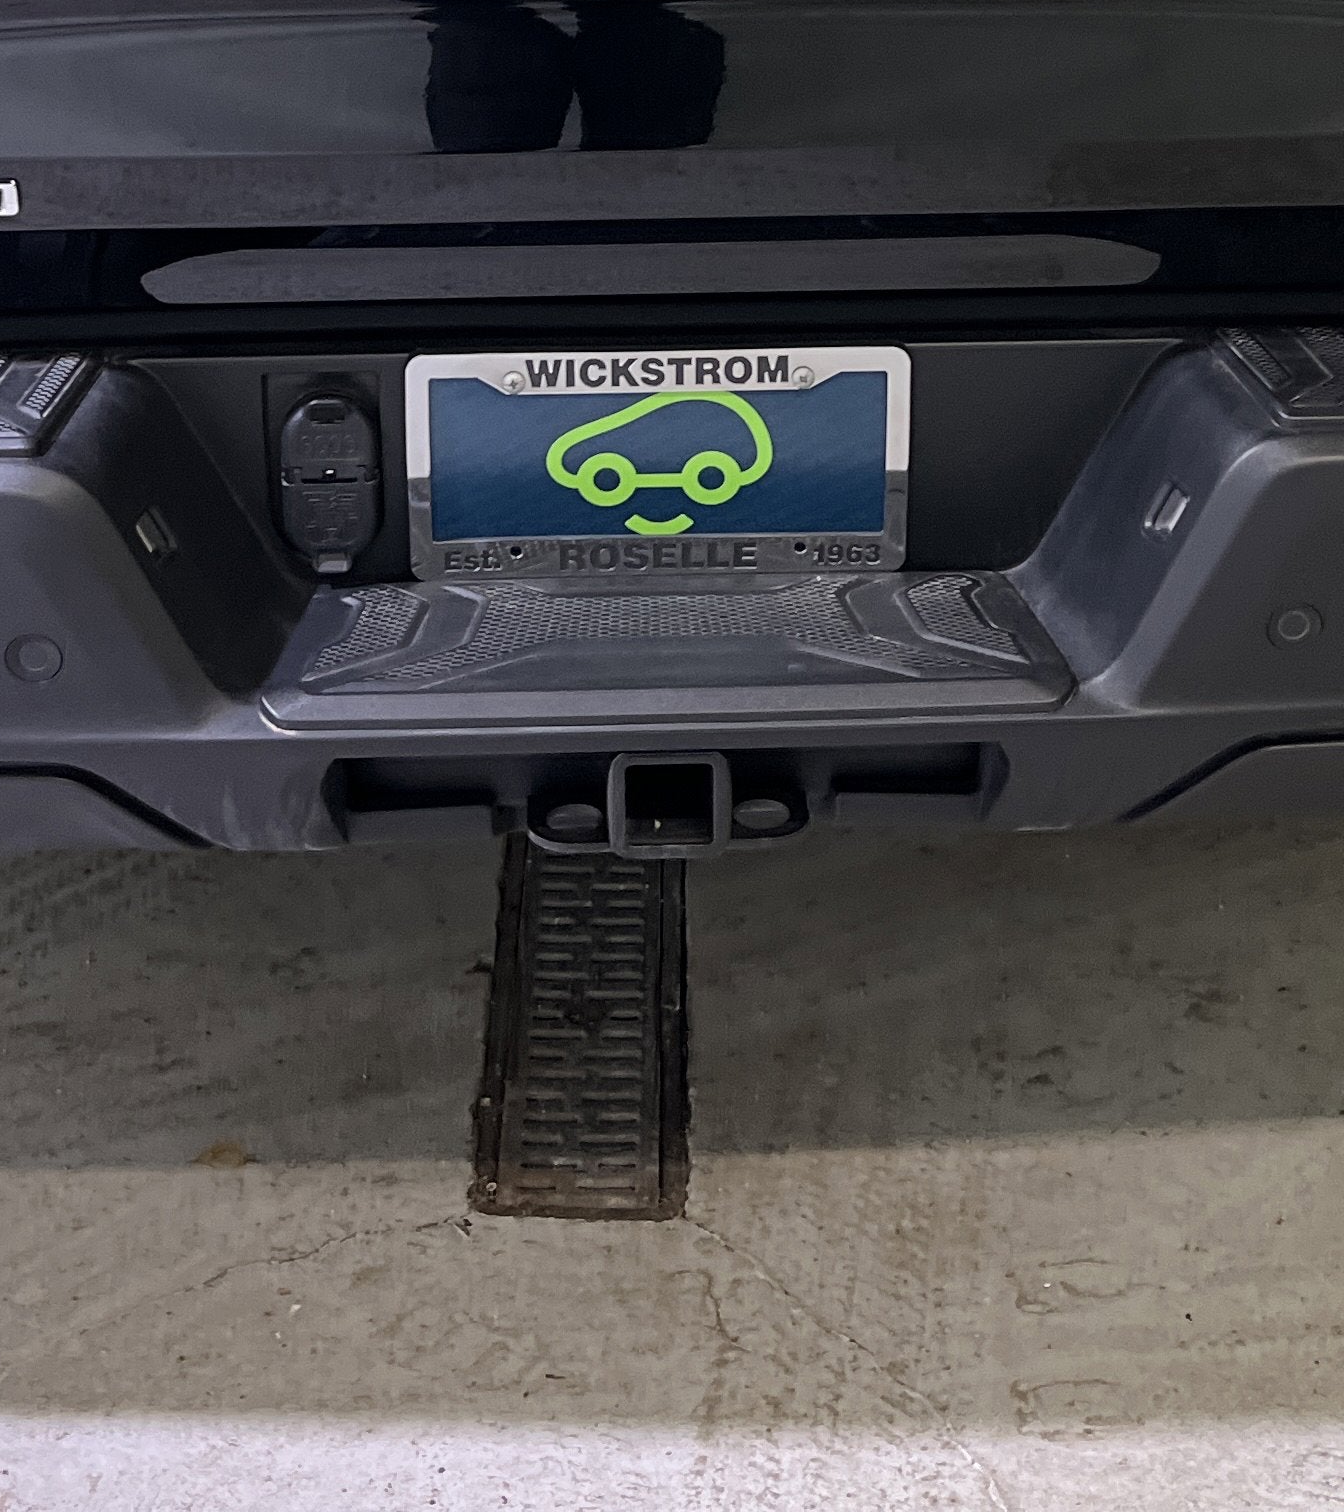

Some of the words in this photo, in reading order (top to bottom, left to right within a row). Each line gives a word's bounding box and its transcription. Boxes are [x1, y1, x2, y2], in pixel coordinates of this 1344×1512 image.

[525, 355, 789, 388] WICKSTROM
[558, 541, 757, 571] ROSELLE
[813, 543, 881, 566] 1963
